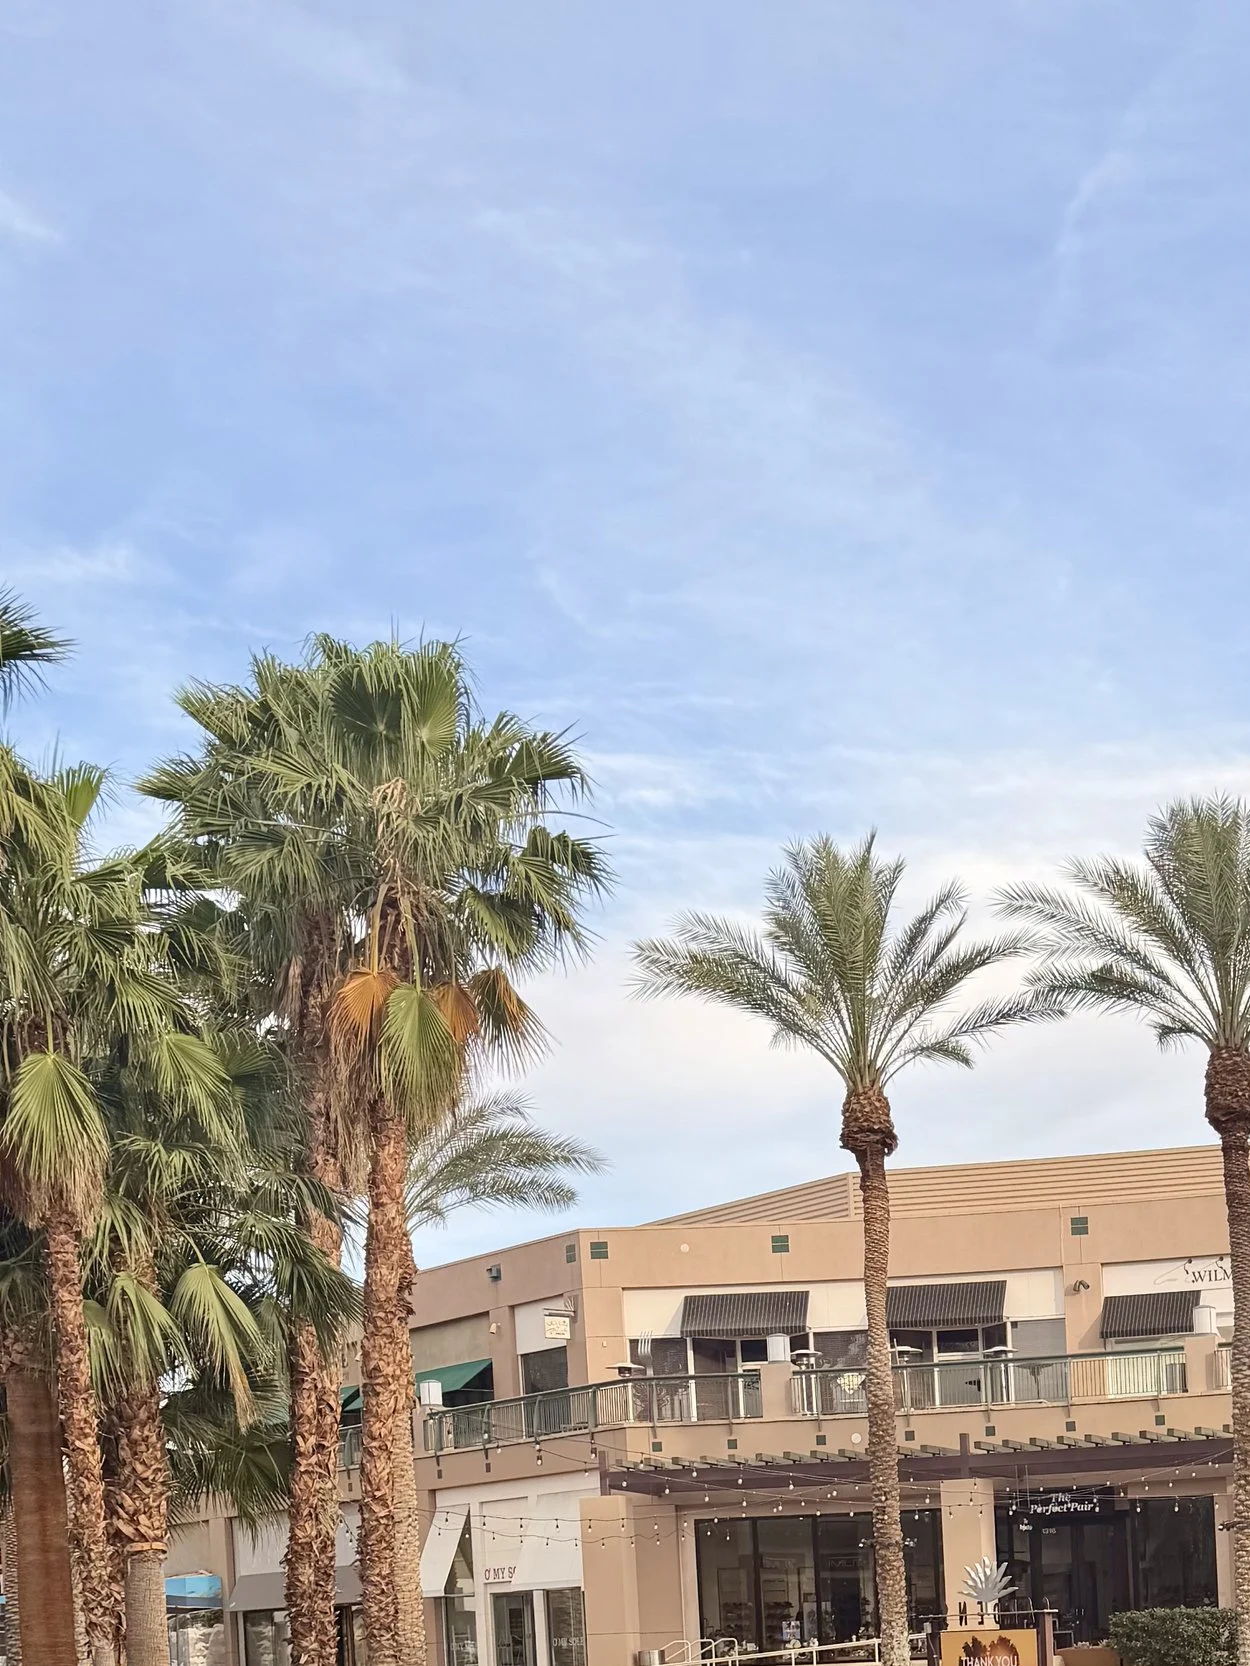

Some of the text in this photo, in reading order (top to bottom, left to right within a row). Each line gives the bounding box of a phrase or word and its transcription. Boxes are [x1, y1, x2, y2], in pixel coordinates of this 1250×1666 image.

[1192, 1268, 1234, 1283] WILM
[1051, 1492, 1072, 1503] The
[1029, 1501, 1094, 1516] Perfect Pair
[493, 1567, 506, 1580] MY
[507, 1566, 517, 1579] S
